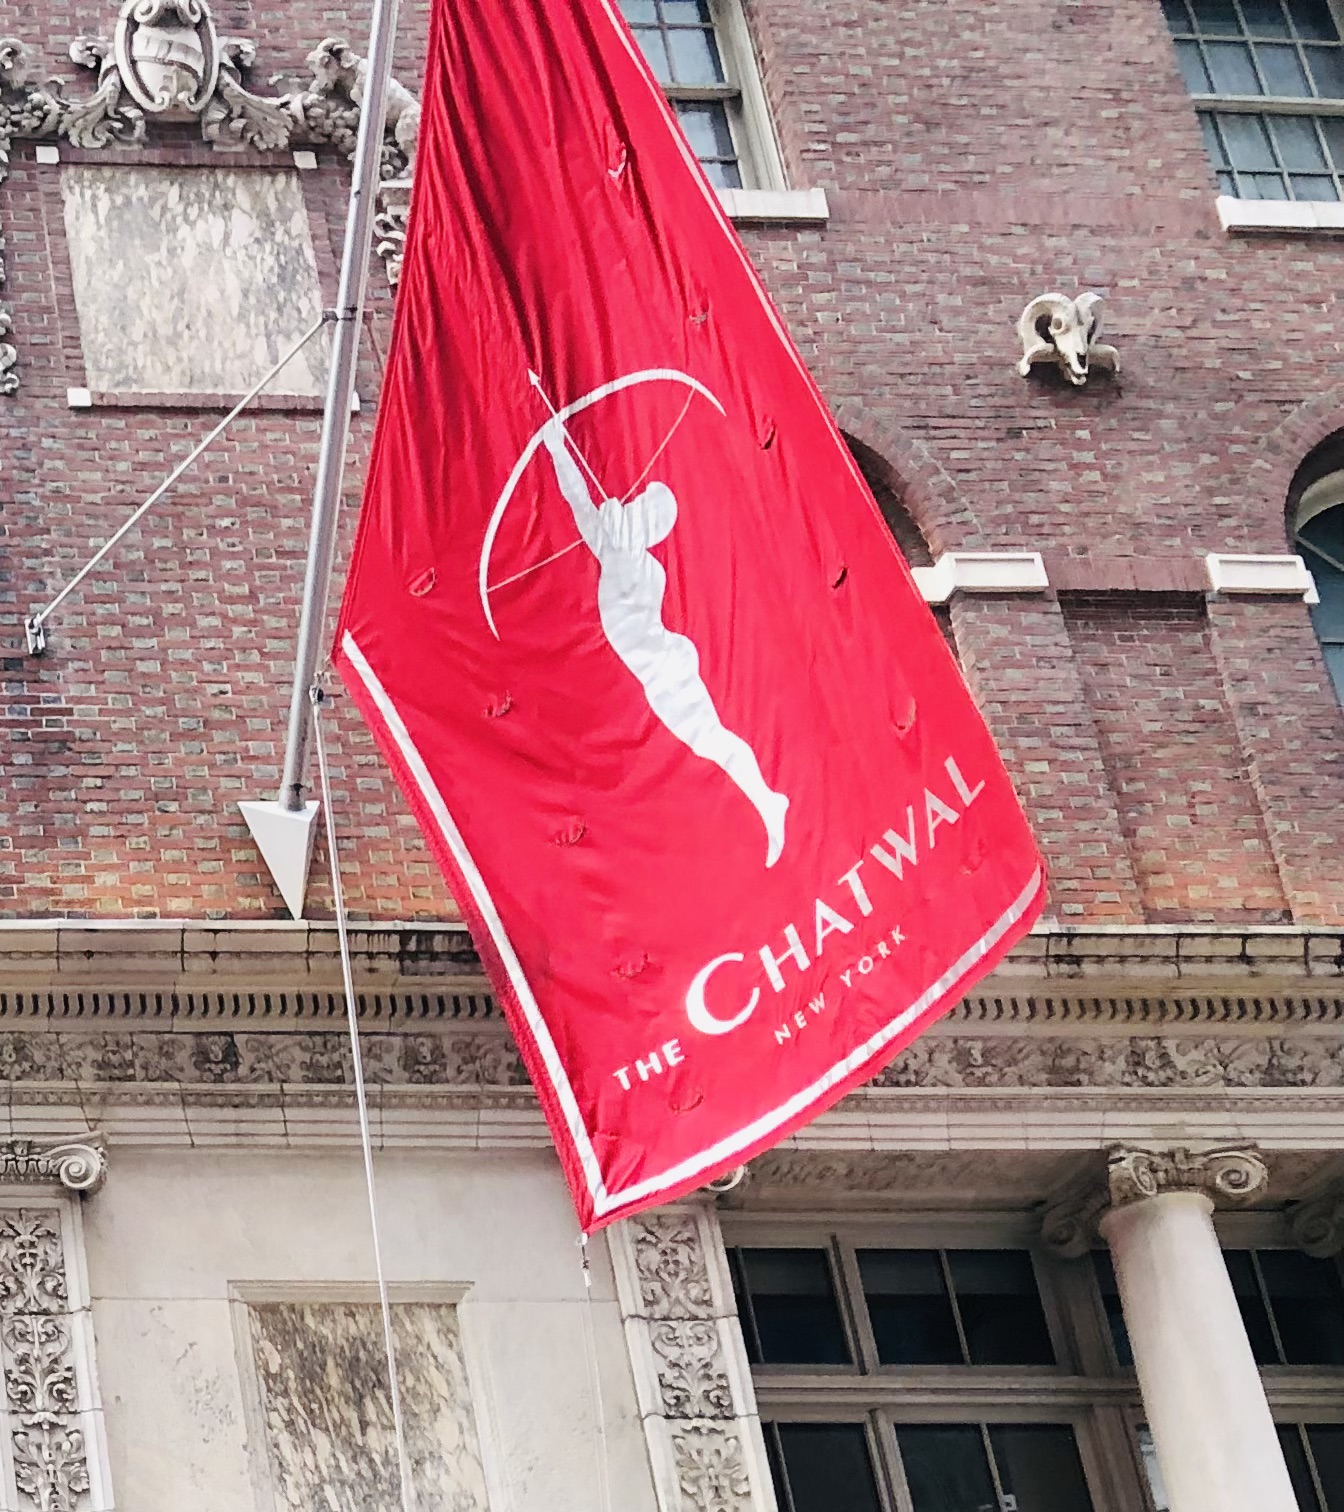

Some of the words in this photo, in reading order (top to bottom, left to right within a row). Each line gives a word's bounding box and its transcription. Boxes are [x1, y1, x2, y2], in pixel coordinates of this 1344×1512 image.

[612, 1038, 686, 1091] THE
[684, 755, 986, 1036] CHATWAL
[773, 993, 827, 1046] NEW
[839, 925, 907, 989] YORK
